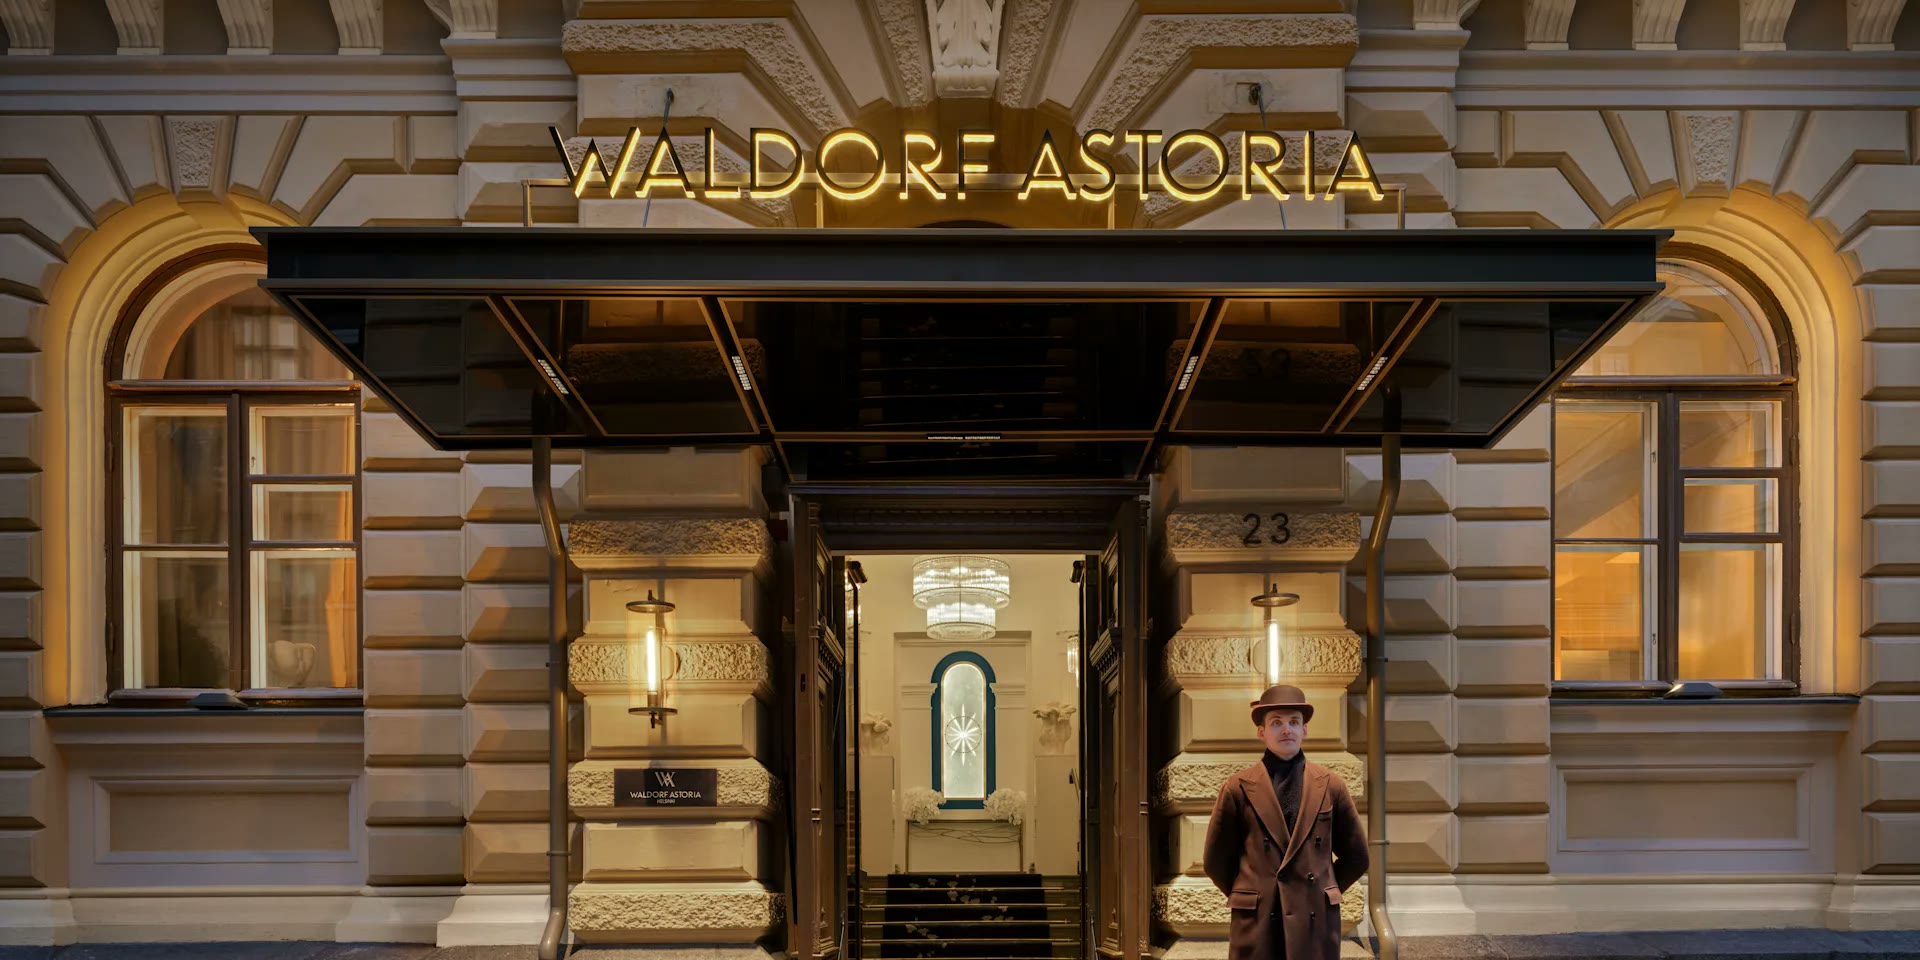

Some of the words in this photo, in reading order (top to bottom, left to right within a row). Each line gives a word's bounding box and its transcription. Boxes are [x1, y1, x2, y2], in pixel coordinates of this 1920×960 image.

[548, 126, 995, 200] WALDORF
[1017, 128, 1385, 201] ASTORIA
[1243, 512, 1290, 545] 23
[669, 791, 701, 799] ASTORIA
